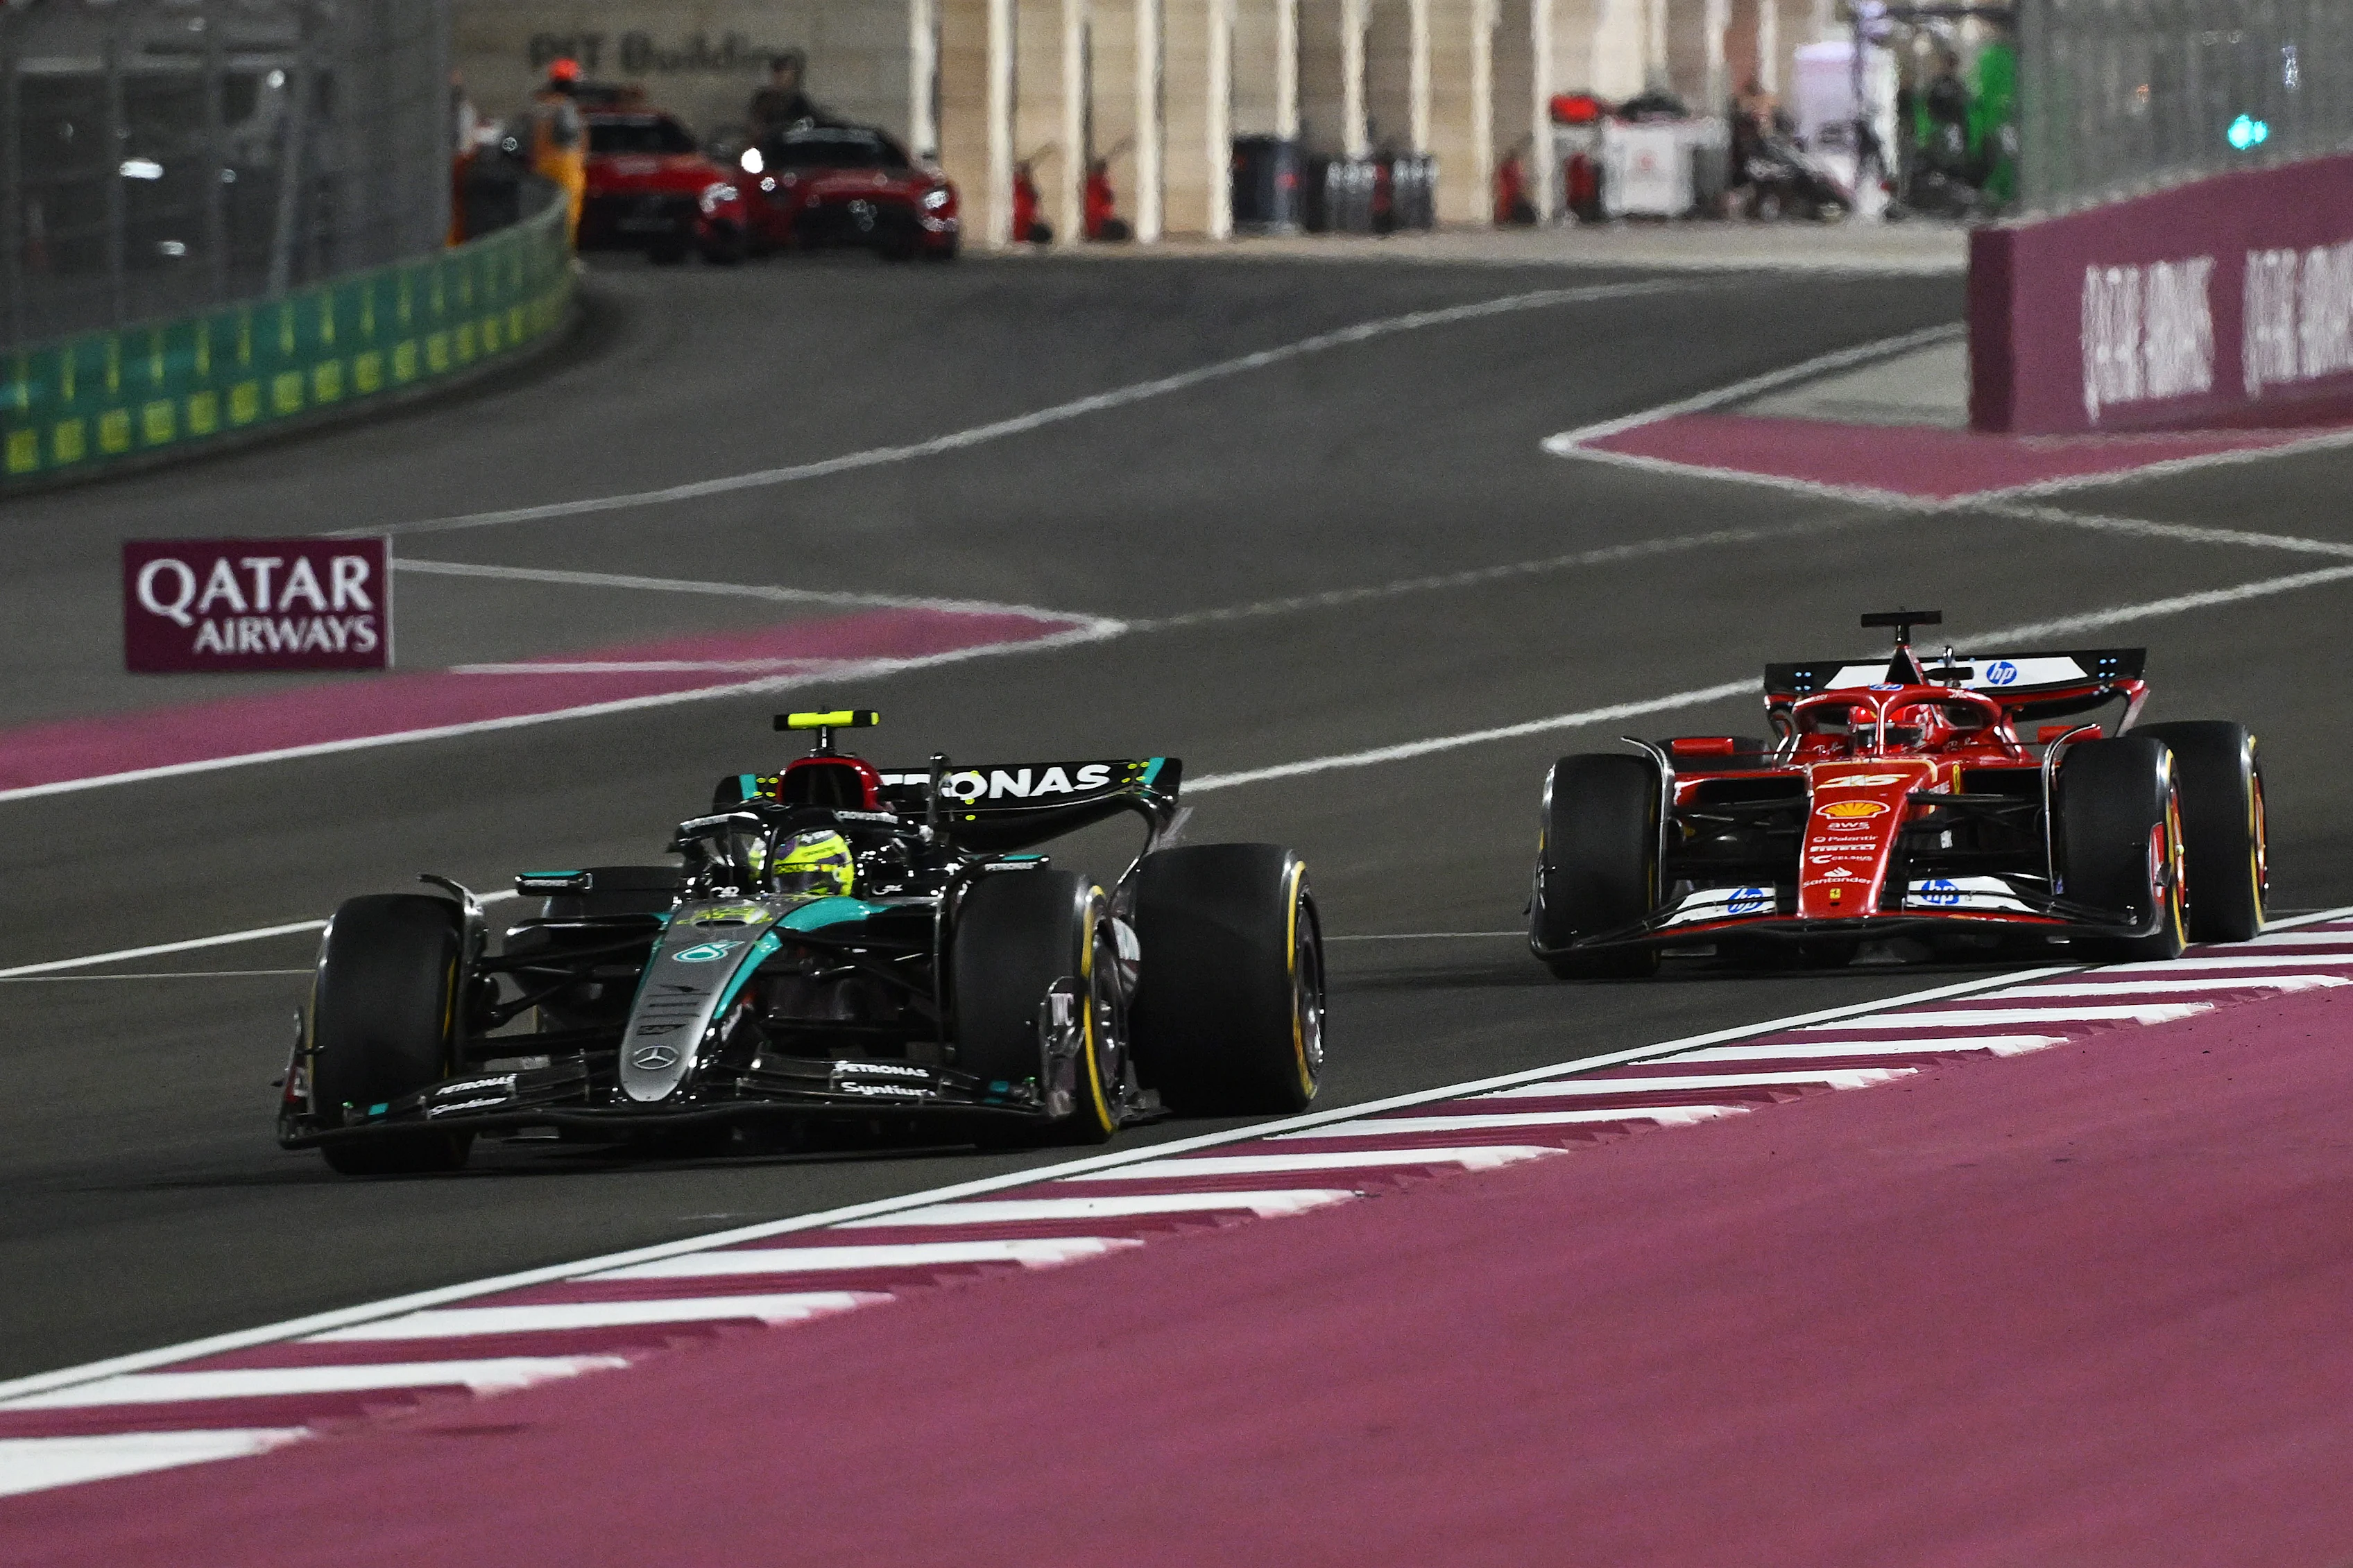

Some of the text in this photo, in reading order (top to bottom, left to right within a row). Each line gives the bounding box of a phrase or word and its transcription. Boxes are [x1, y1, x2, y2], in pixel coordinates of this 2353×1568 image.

[136, 555, 373, 628] QATAR
[192, 614, 378, 655] AIRWAYS
[1988, 661, 2016, 685] hp
[834, 1061, 930, 1077] PETRONAS
